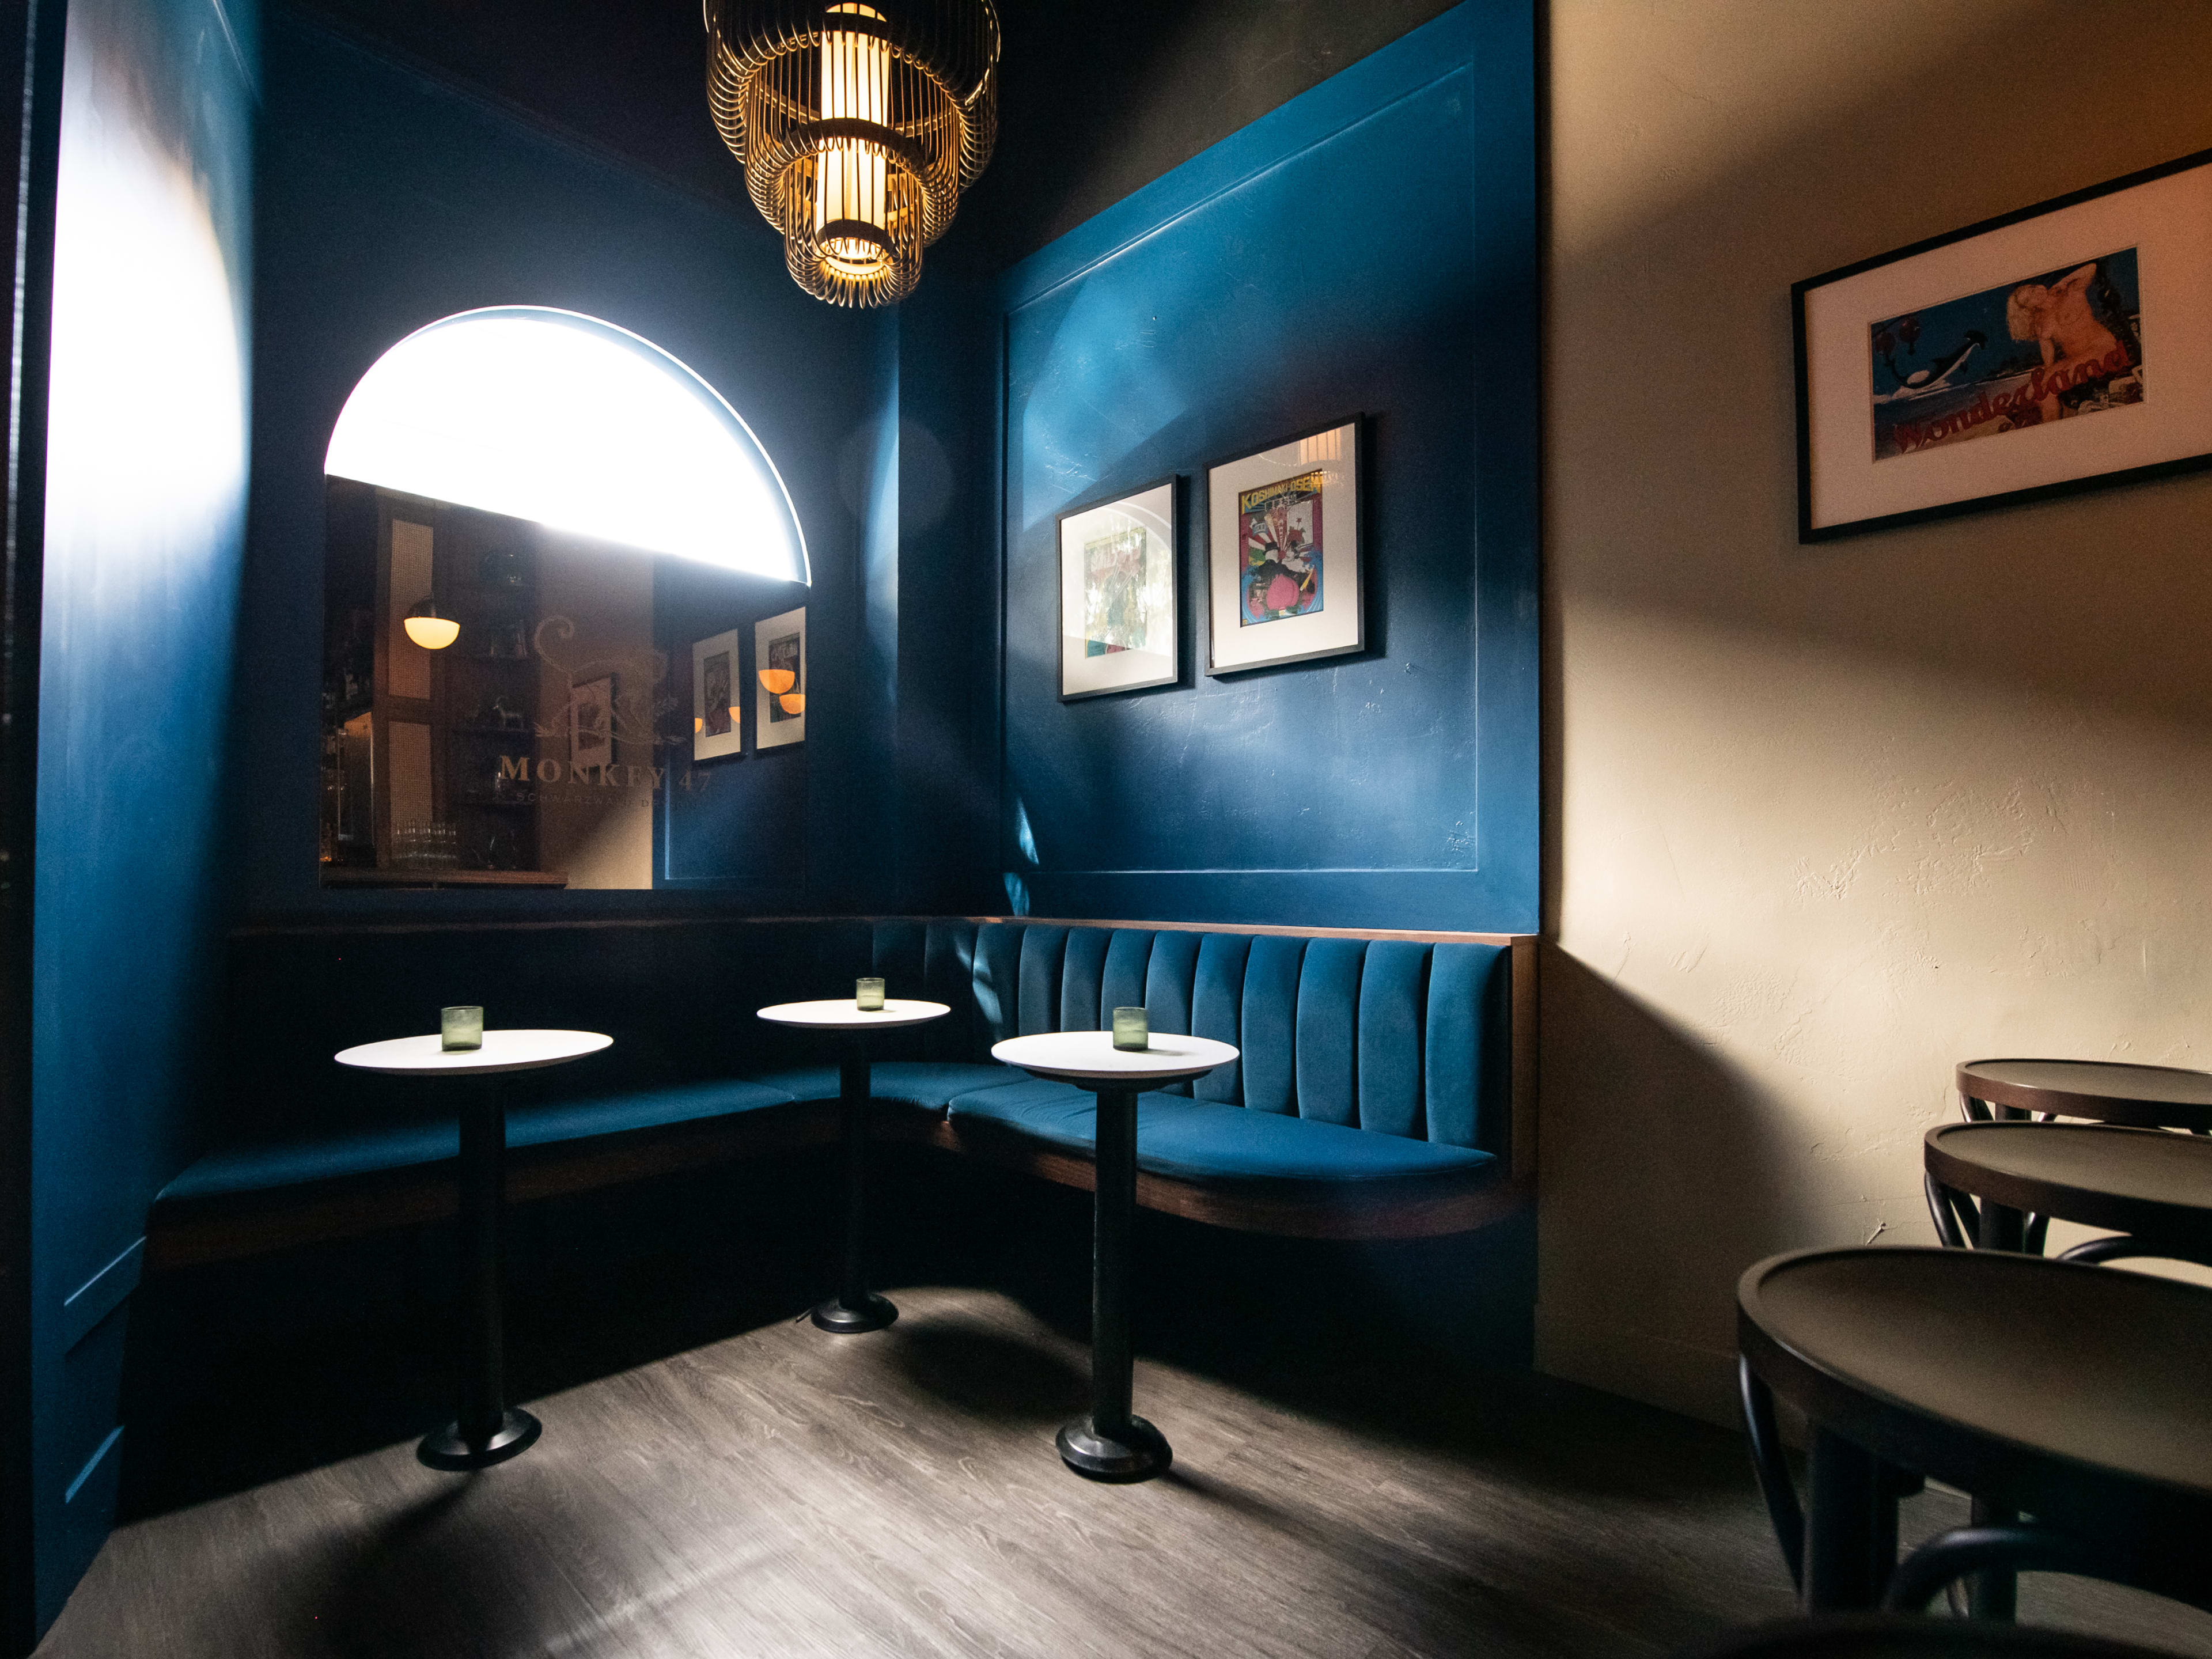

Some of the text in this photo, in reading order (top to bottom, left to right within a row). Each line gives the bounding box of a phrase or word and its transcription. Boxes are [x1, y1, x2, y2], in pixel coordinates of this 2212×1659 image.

[1892, 339, 2135, 454] Wonderland
[500, 755, 713, 793] MONKEY 47
[516, 791, 632, 808] SCHWARZWA
